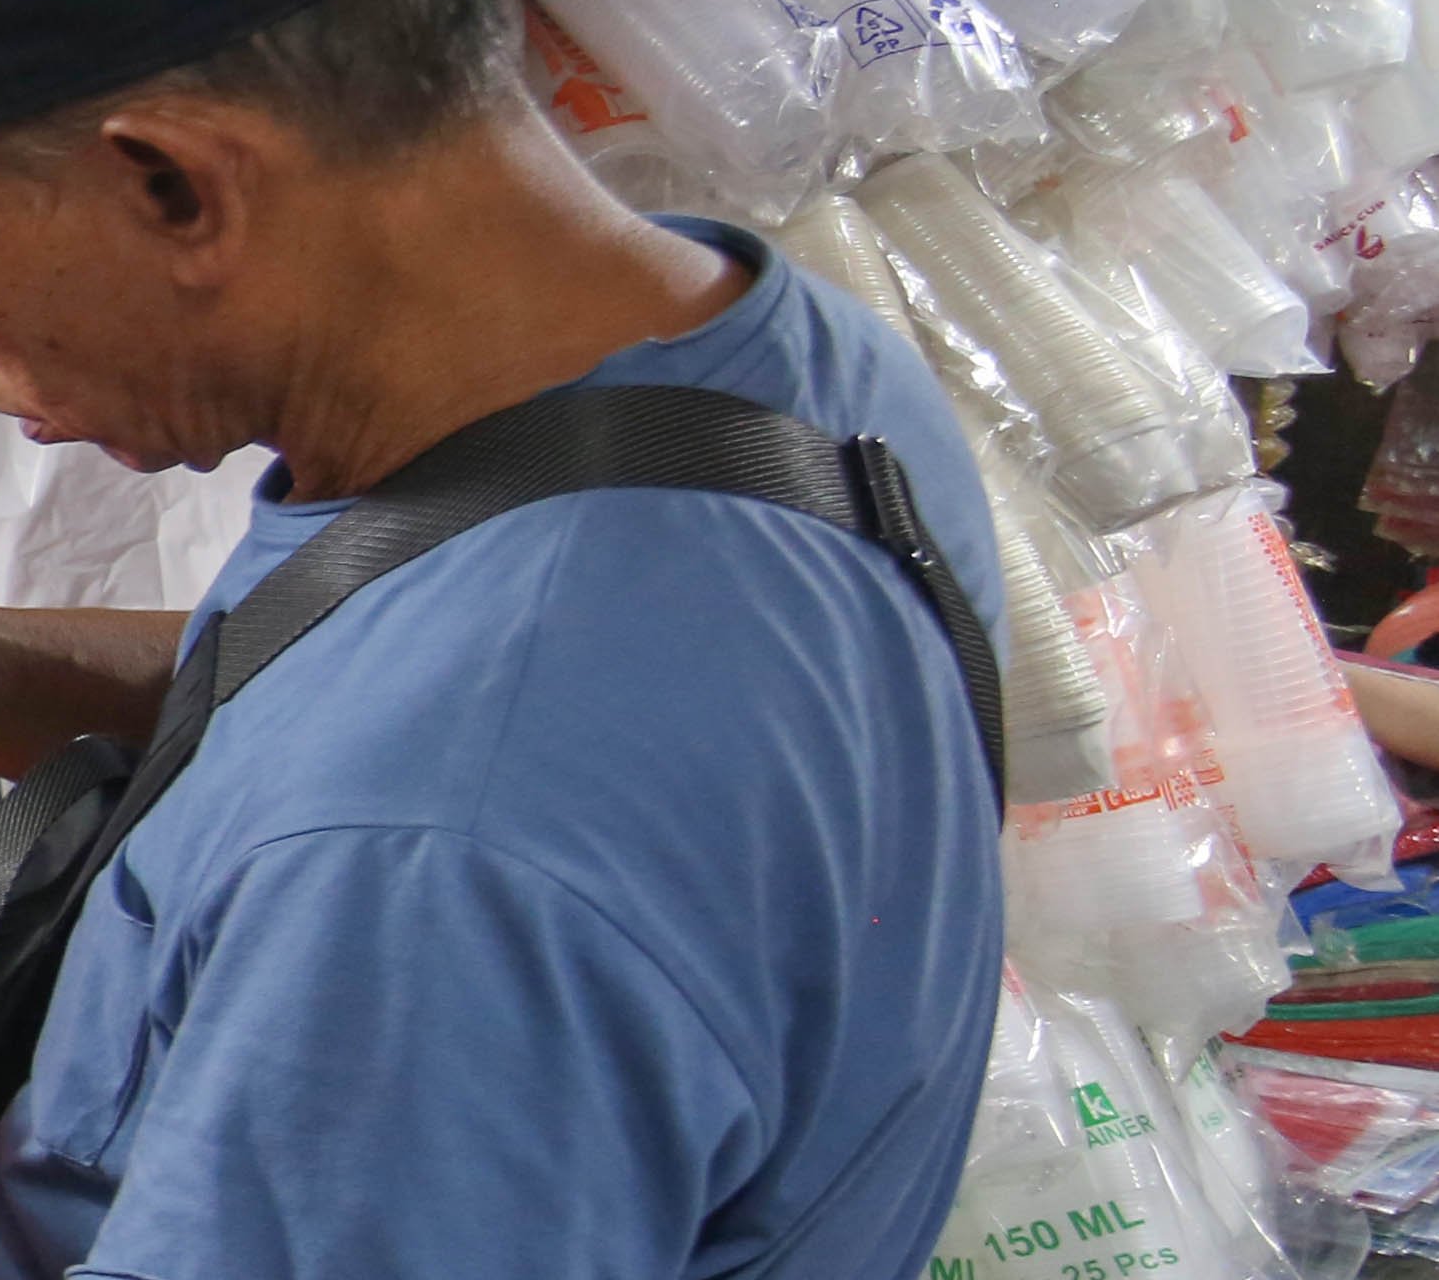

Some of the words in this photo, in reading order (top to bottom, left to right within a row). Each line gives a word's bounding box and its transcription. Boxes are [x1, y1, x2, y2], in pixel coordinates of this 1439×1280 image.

[984, 1219, 1061, 1263] 150
[1066, 1199, 1147, 1242] ML
[1112, 1246, 1181, 1278] Pcs
